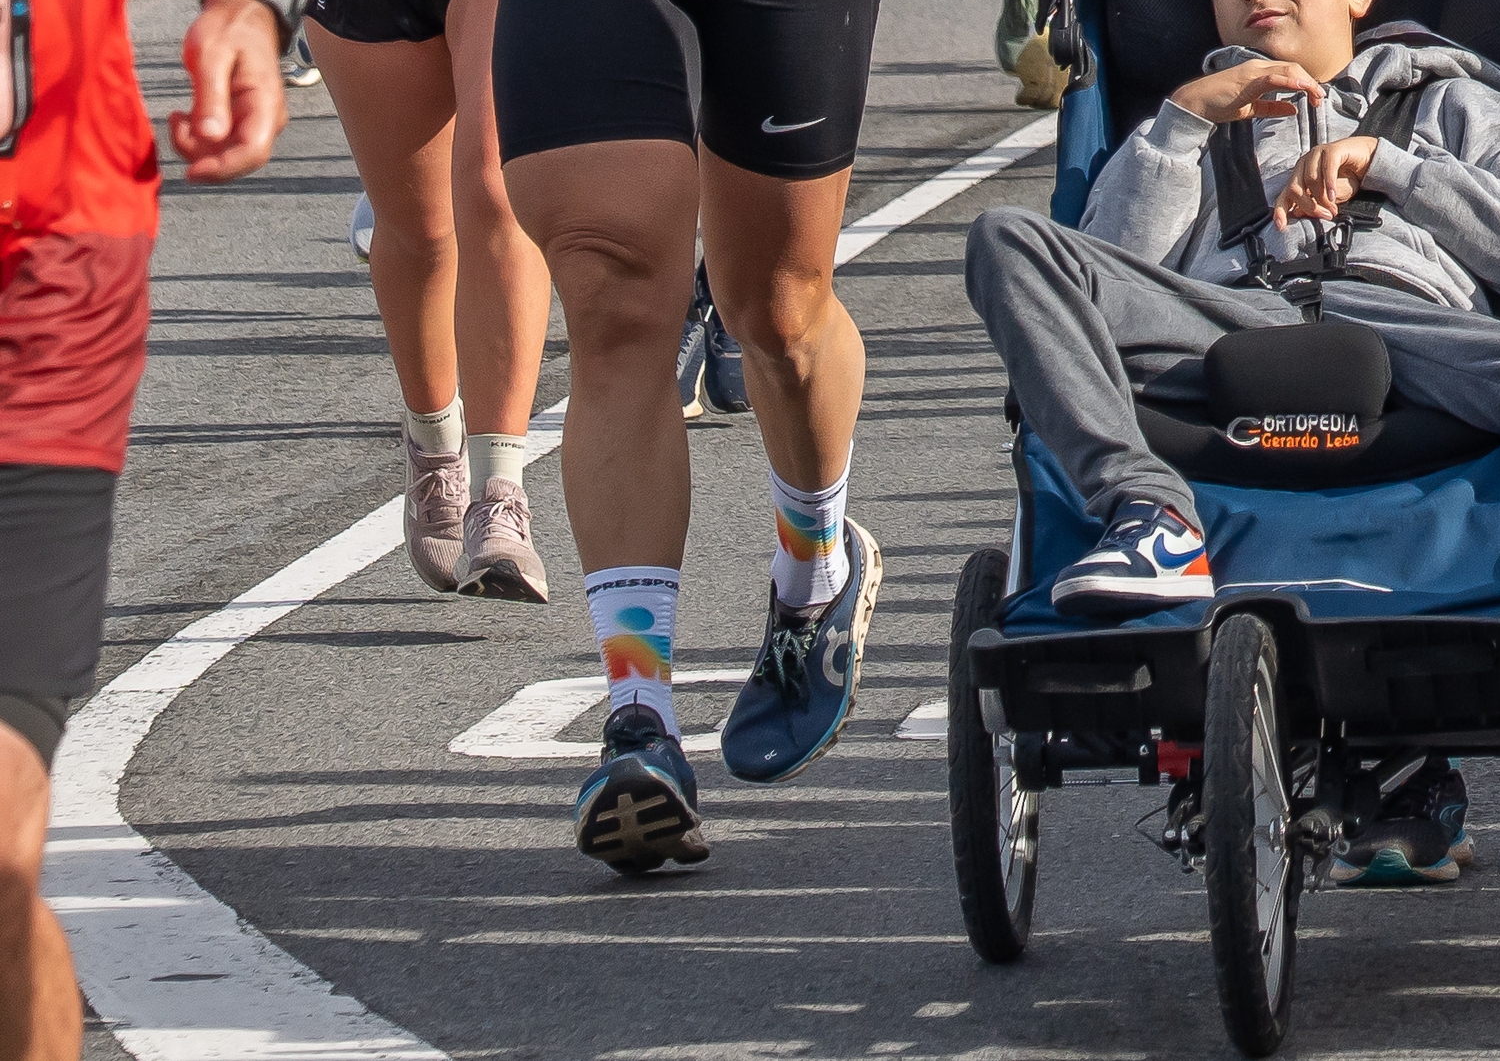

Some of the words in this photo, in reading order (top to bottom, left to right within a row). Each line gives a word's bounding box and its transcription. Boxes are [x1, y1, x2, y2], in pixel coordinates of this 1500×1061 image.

[1263, 414, 1359, 432] ORTOPEDIA
[1262, 432, 1318, 449] Gerardo
[1326, 433, 1360, 448] León
